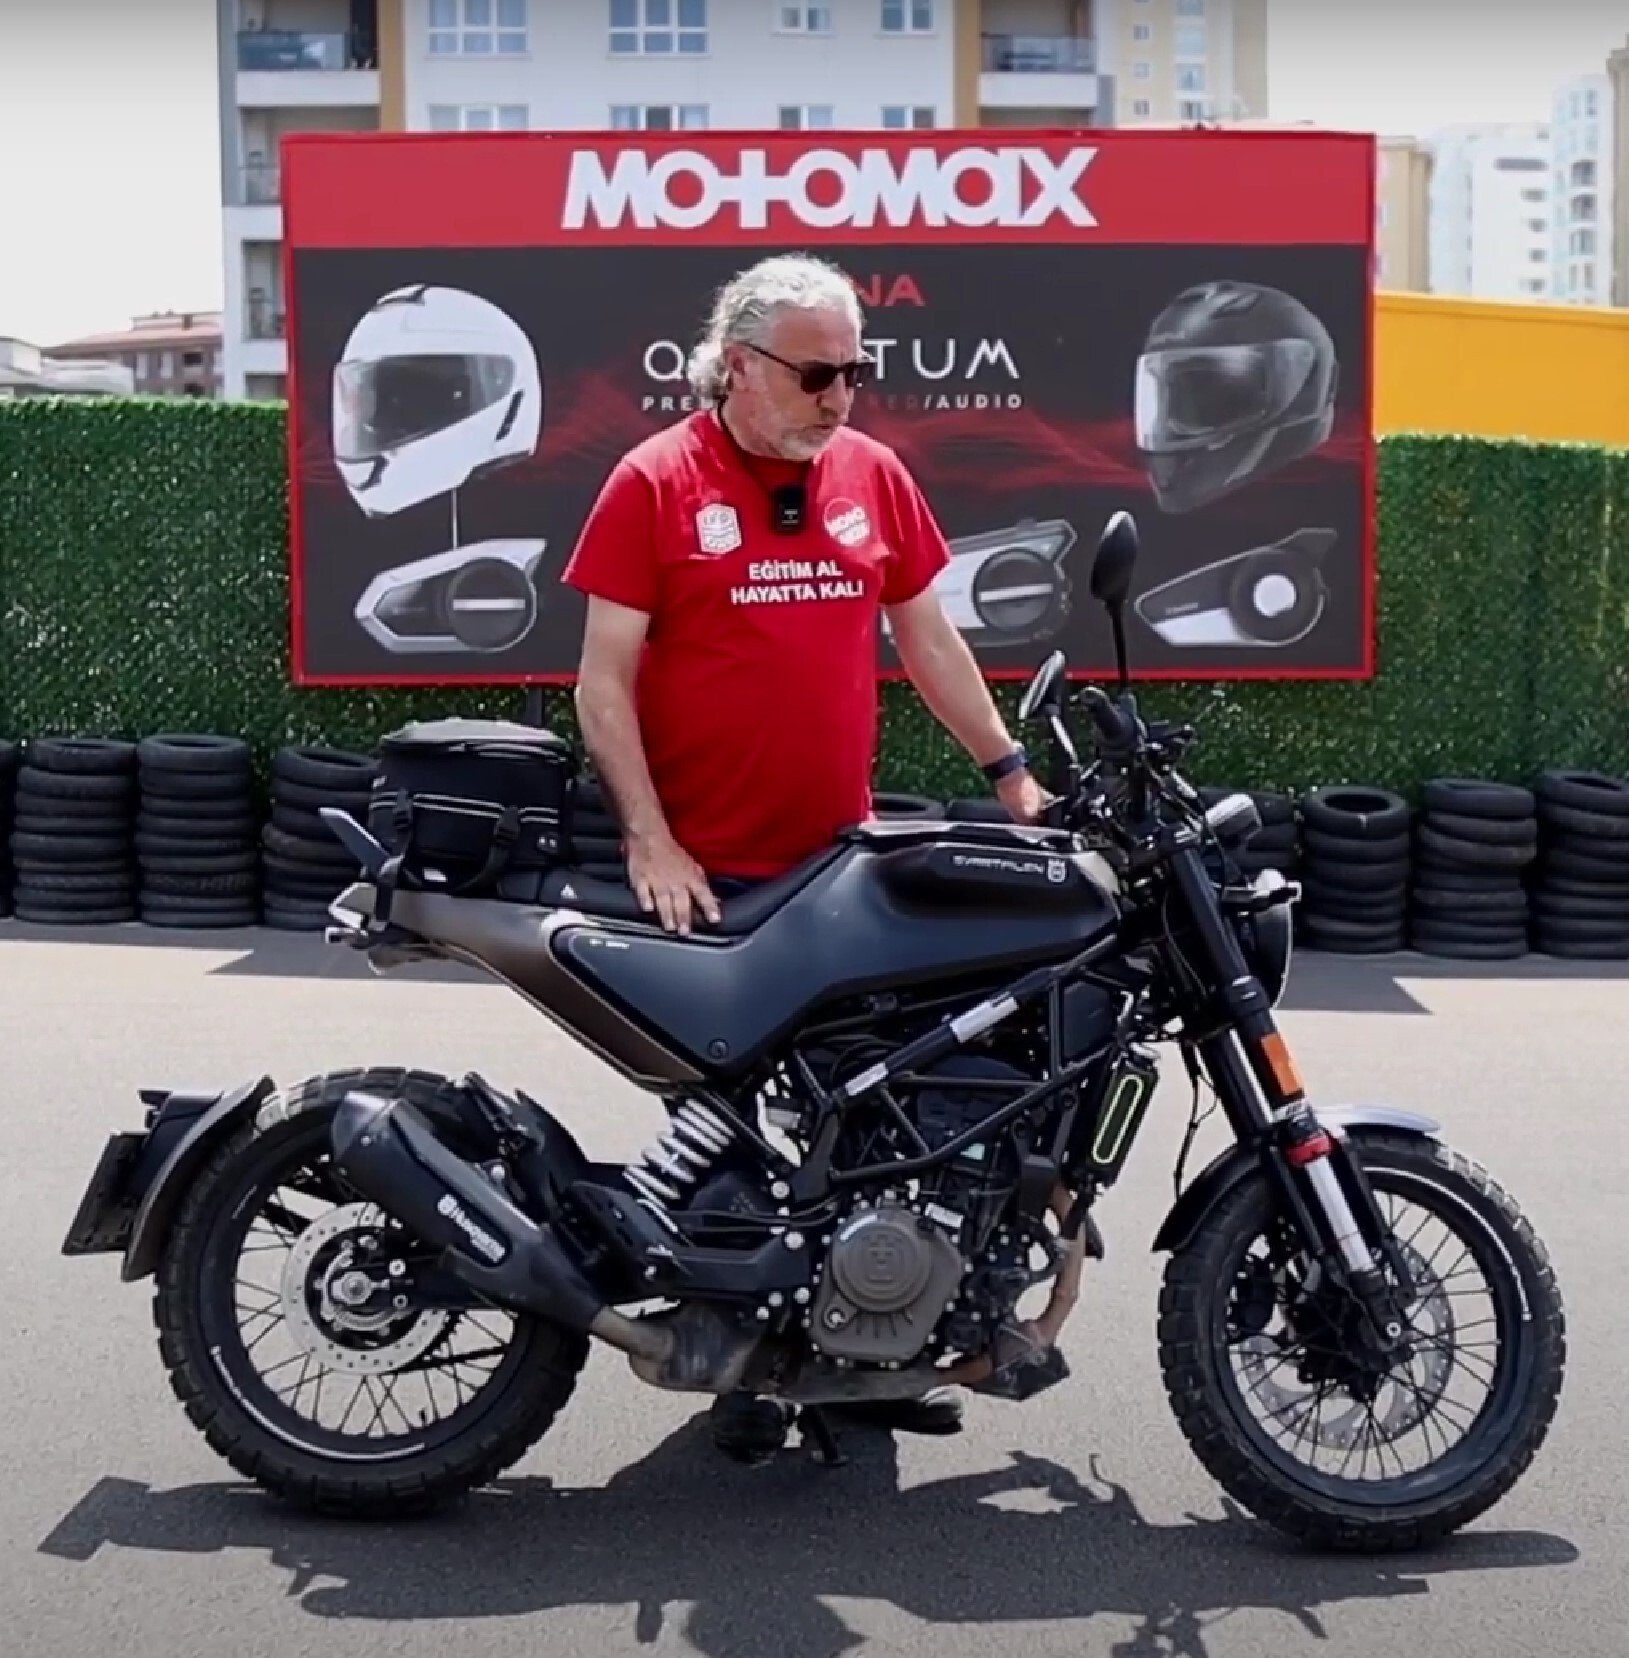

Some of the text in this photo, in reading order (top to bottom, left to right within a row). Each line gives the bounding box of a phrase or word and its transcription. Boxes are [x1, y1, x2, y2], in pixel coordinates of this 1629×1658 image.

[854, 273, 926, 307] NA
[643, 337, 1020, 381] QTUM
[749, 559, 844, 581] EĞİTİM AL
[730, 583, 817, 605] HAYATTA
